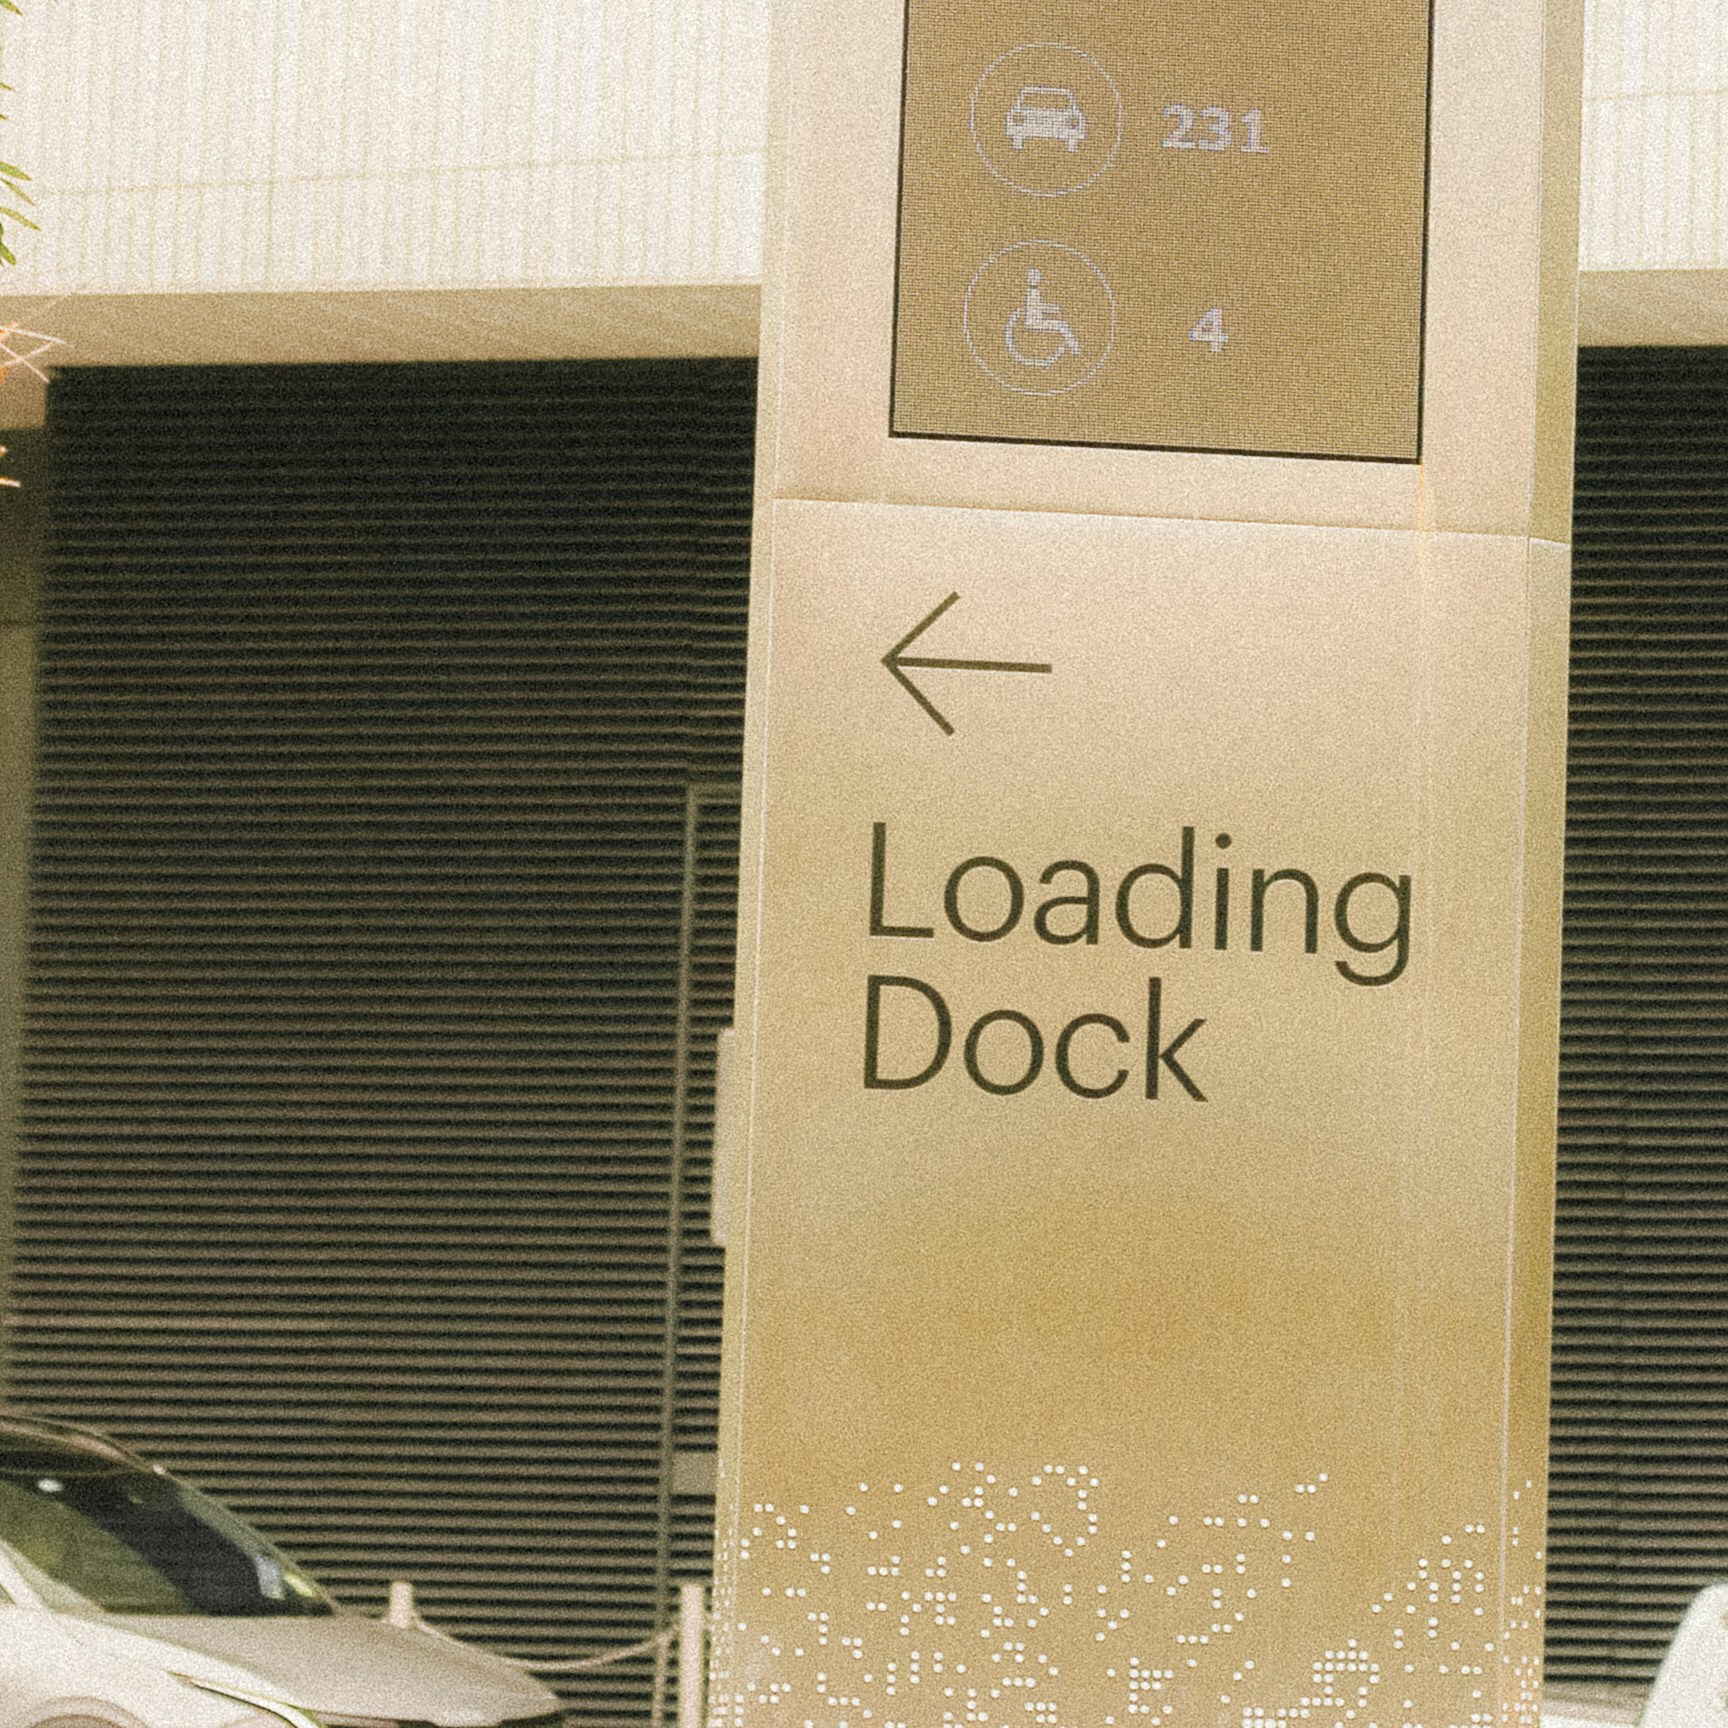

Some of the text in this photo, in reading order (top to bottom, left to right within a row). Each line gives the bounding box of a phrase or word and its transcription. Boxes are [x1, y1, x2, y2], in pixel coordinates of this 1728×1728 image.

[1161, 103, 1270, 154] 231
[1189, 307, 1229, 353] 4
[867, 821, 1413, 988] Loading
[862, 973, 1209, 1103] Dock
